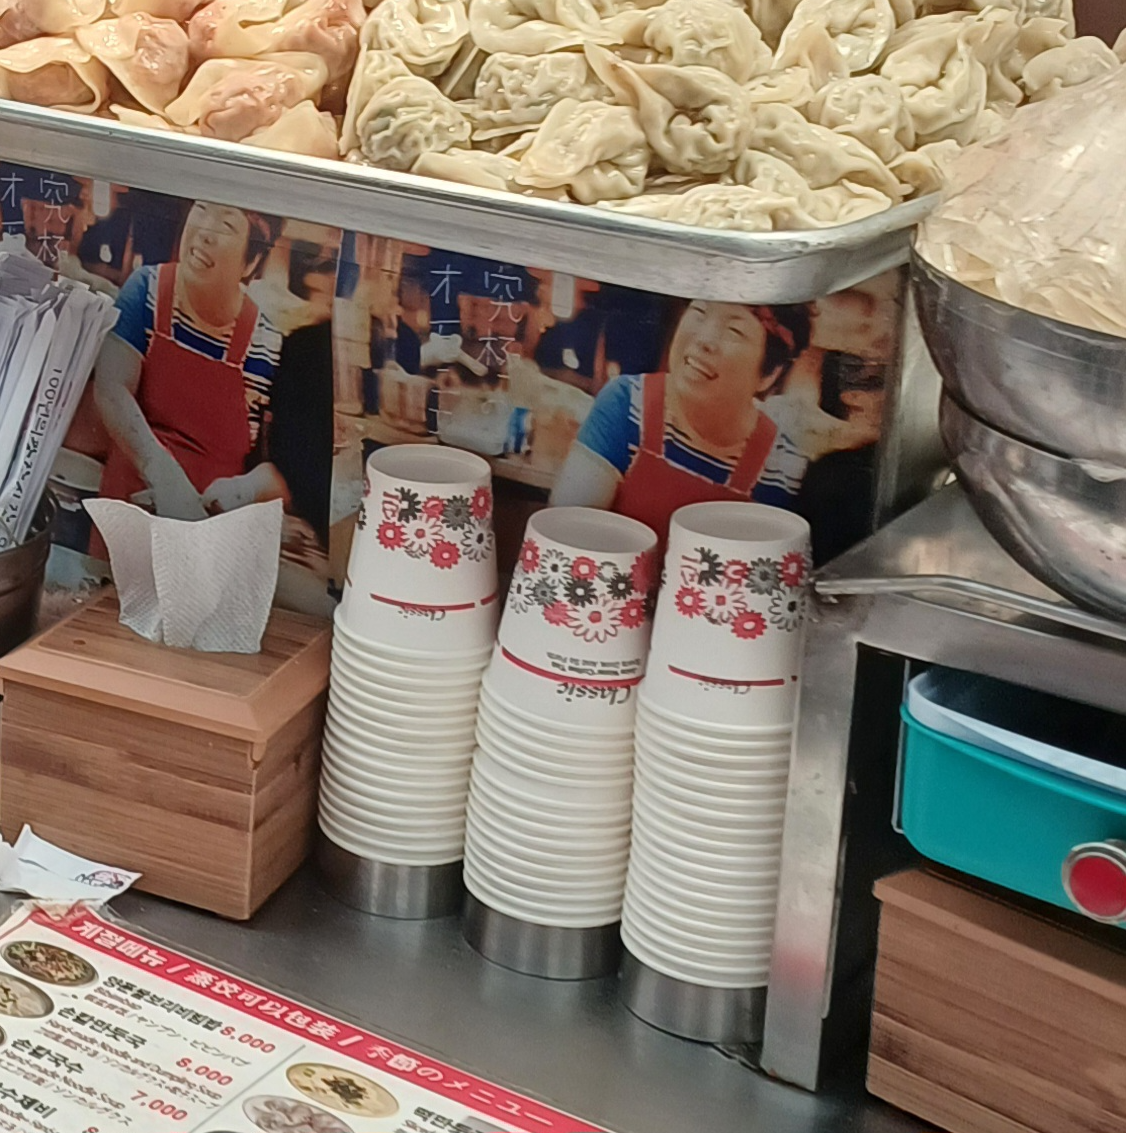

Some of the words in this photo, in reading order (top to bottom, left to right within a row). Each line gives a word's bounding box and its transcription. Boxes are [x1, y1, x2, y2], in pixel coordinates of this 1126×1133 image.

[557, 681, 632, 705] Classic
[73, 919, 168, 969] 계절메뉴
[11, 1038, 86, 1074] 손칼국수
[128, 1091, 187, 1120] 7,000
[176, 1058, 232, 1085] 8,000
